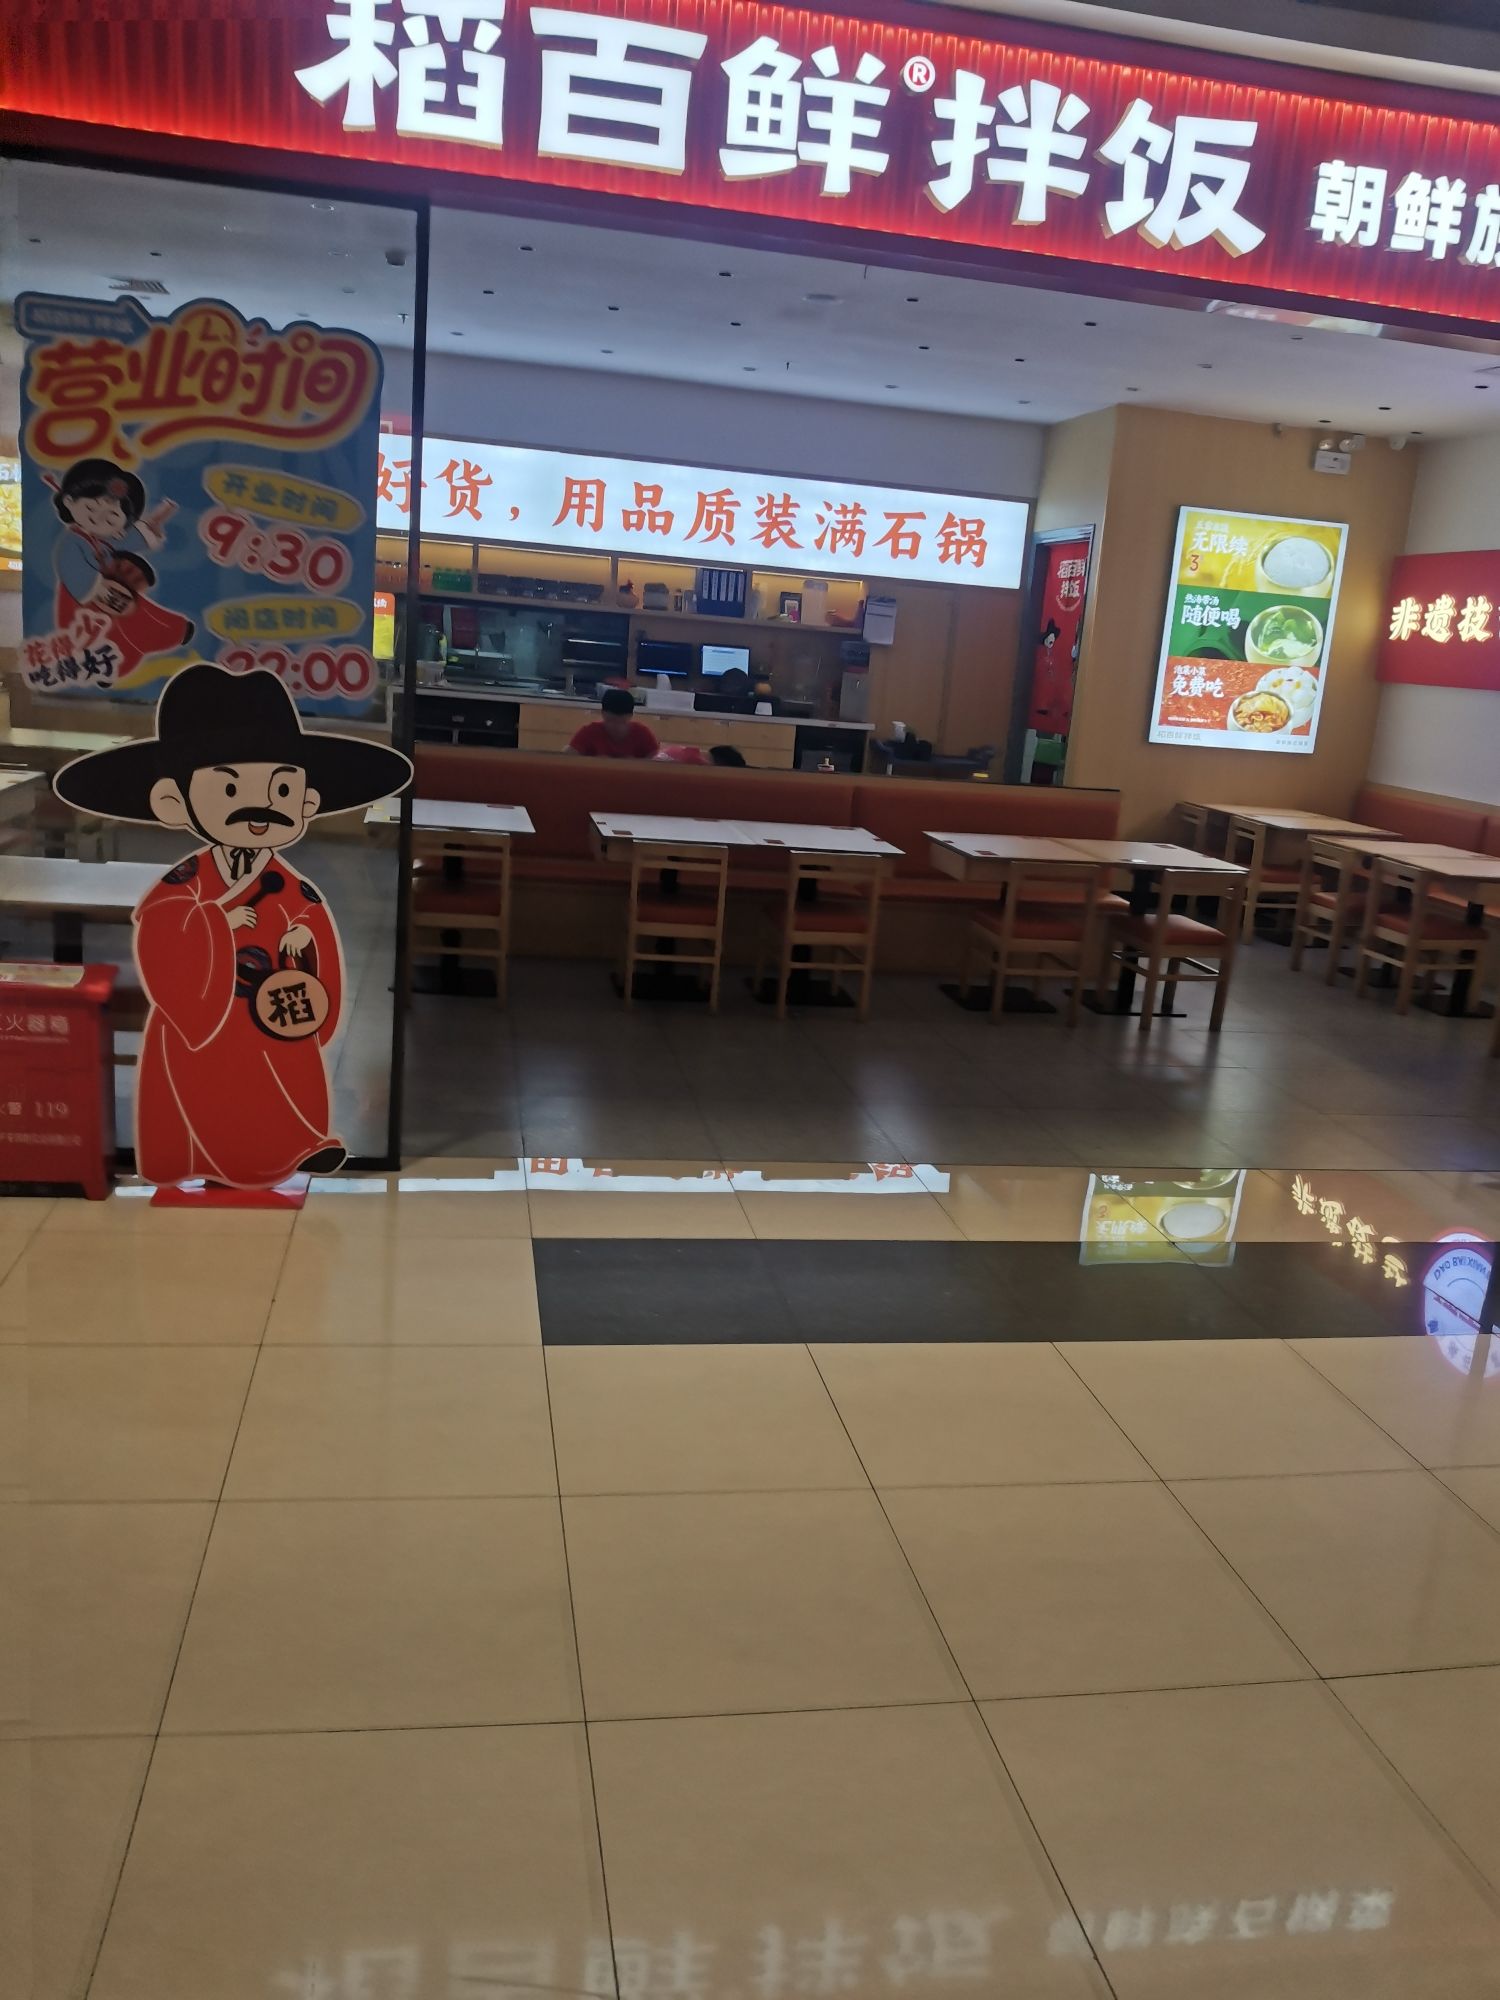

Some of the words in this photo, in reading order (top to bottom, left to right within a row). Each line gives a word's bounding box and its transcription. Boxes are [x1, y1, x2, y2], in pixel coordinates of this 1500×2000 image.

[34, 322, 369, 460] 营业时间
[376, 451, 988, 569] 好货，用品质装满石锅
[207, 514, 344, 587] 9:30
[1181, 604, 1241, 630] 随便喝
[1389, 593, 1500, 644] 非遗技
[1170, 675, 1225, 698] 免费吃
[0, 1013, 70, 1035] 火器箱
[267, 982, 316, 1027] 稻
